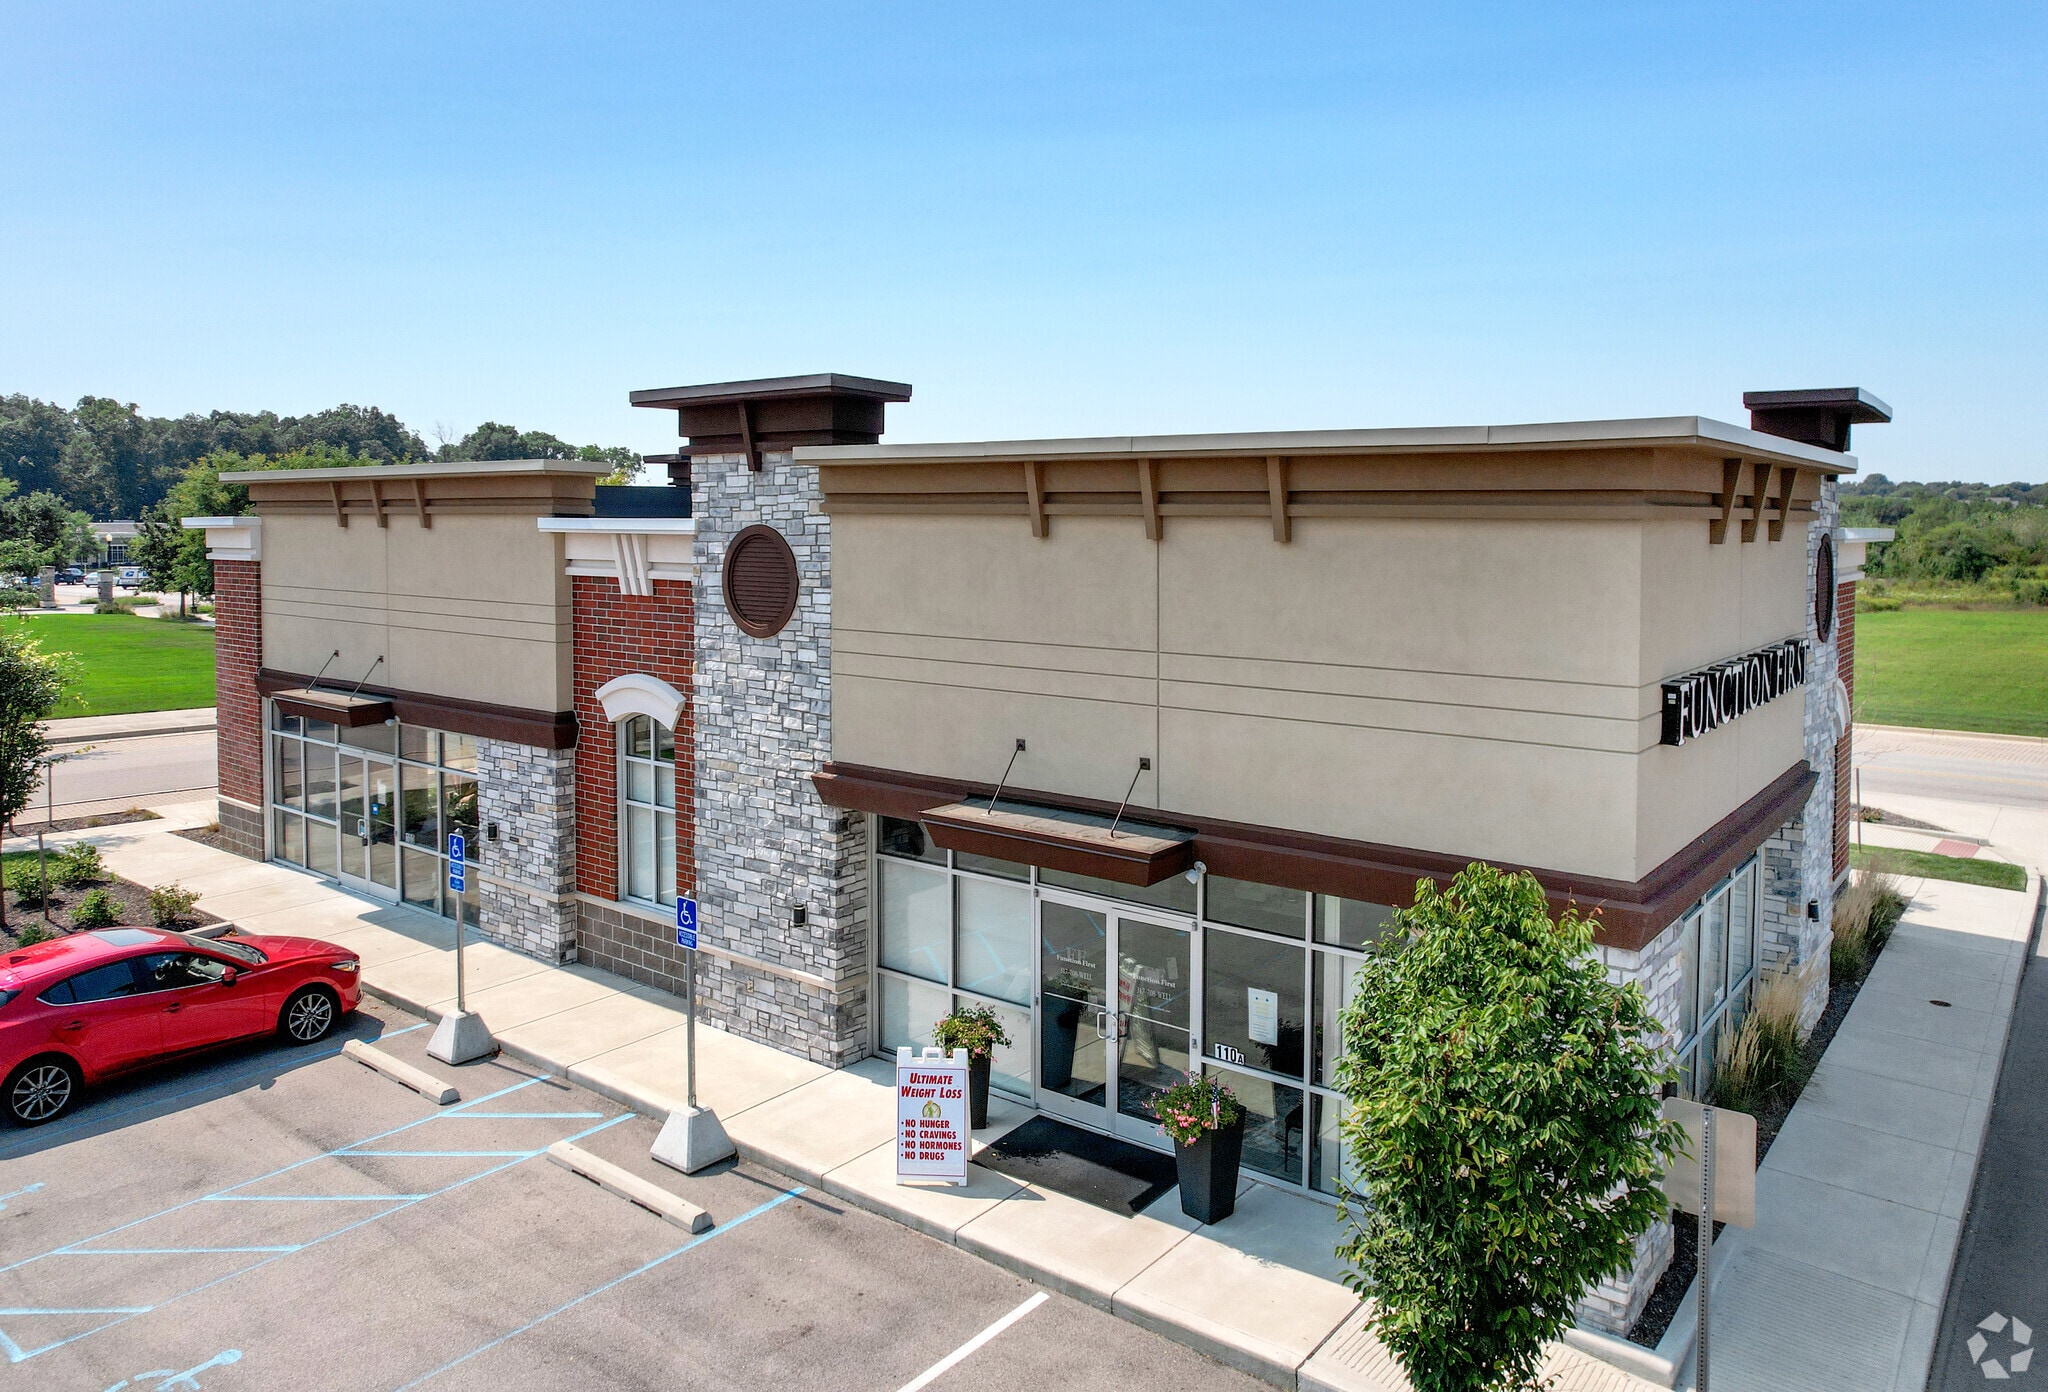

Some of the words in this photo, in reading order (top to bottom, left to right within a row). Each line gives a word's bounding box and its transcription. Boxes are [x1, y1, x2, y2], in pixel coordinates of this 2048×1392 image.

[1674, 650, 1773, 746] FUNCTION
[1775, 638, 1810, 698] FIRST
[1082, 960, 1096, 969] First
[1161, 980, 1176, 989] First
[909, 1072, 953, 1085] ULTIMATE
[901, 1085, 936, 1098] WEIGHT
[939, 1087, 962, 1099] LOSS
[905, 1119, 916, 1128] NO
[919, 1119, 950, 1129] HUNGER
[905, 1129, 916, 1139] NO
[919, 1130, 957, 1140] CRAVINGS
[904, 1140, 916, 1149] NO
[919, 1141, 962, 1151] HORMONES
[904, 1151, 916, 1160] NO
[919, 1151, 945, 1161] DRUGS
